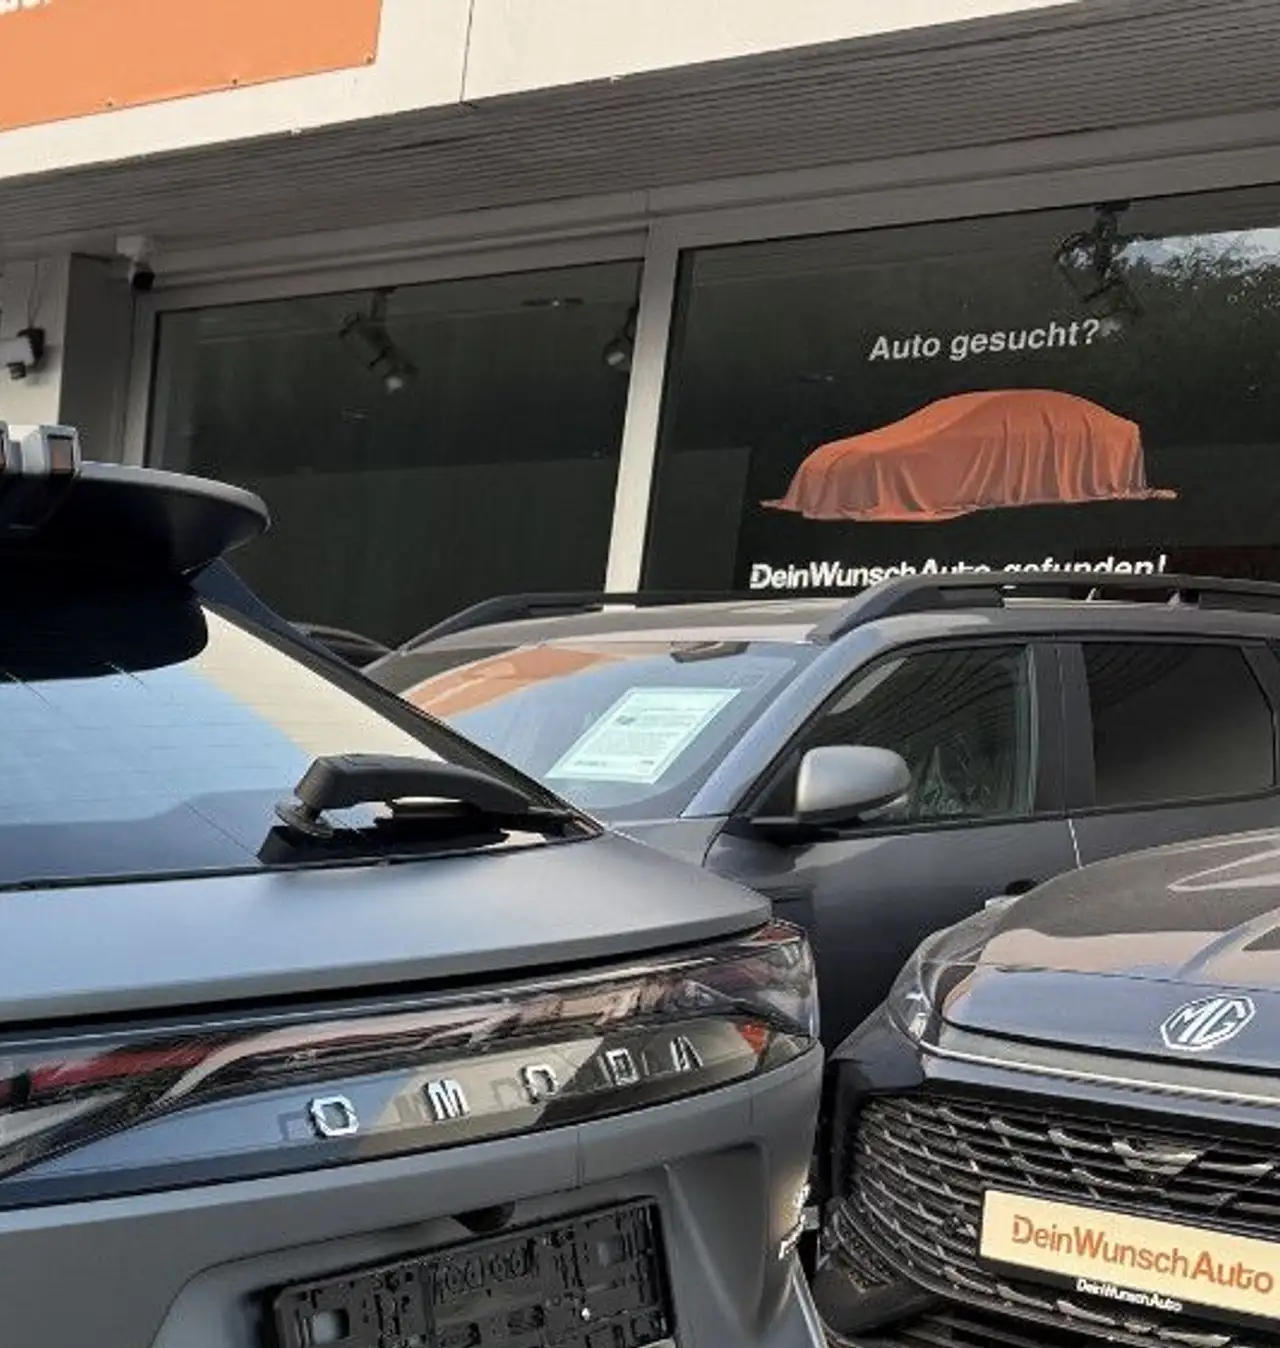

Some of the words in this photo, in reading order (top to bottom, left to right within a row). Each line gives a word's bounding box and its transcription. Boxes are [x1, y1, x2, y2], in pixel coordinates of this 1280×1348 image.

[868, 335, 941, 361] Auto
[950, 318, 1100, 362] gesucht?
[1166, 997, 1251, 1047] MG
[1011, 1214, 1274, 1294] DeinWunschAuto
[1076, 1277, 1183, 1313] DeinWunschAuto
